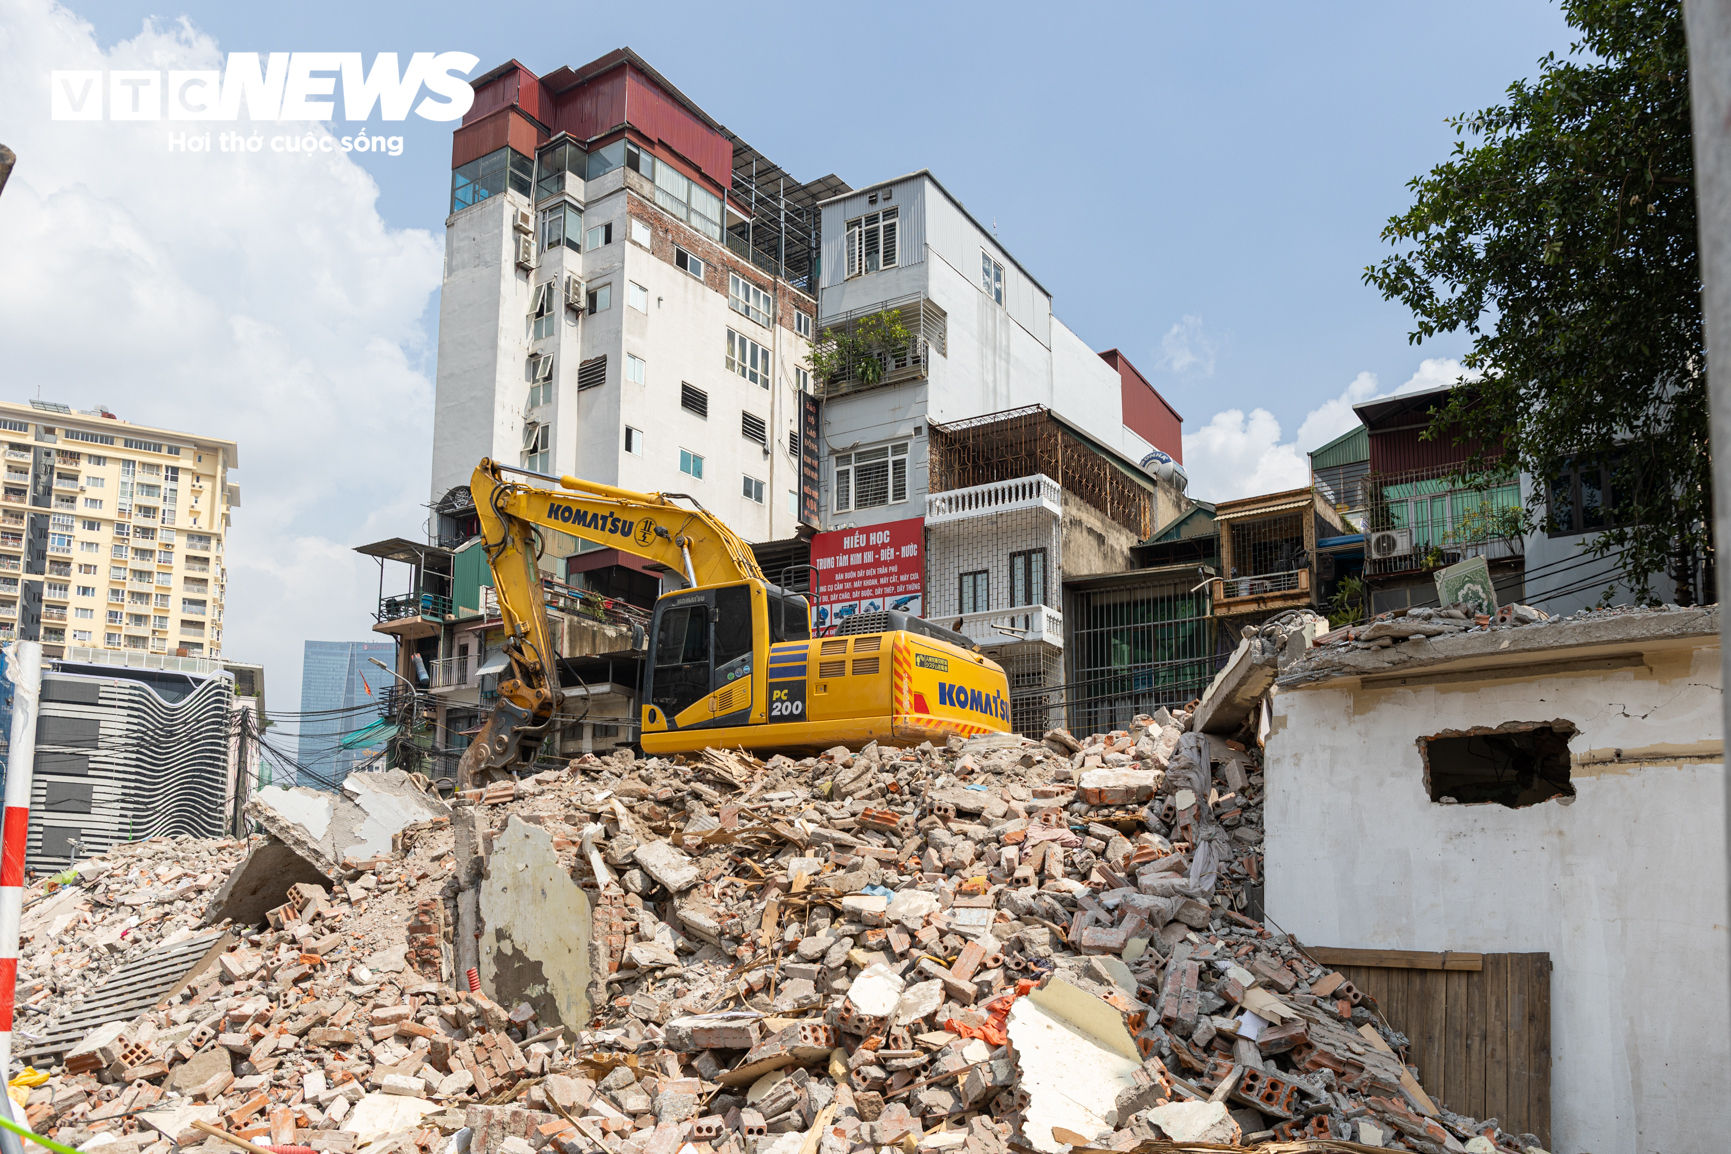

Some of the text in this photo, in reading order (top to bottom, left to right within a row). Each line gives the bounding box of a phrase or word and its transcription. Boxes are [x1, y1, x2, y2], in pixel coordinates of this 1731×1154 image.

[547, 502, 634, 537] KOMATSU
[869, 530, 890, 547] HỌC
[816, 556, 835, 570] TRUNG
[835, 552, 849, 568] TÂM
[850, 552, 862, 565] KIM
[880, 546, 894, 563] ĐIỆN
[772, 689, 788, 701] PC
[938, 682, 1010, 724] KOMATSU
[771, 701, 802, 716] 200
